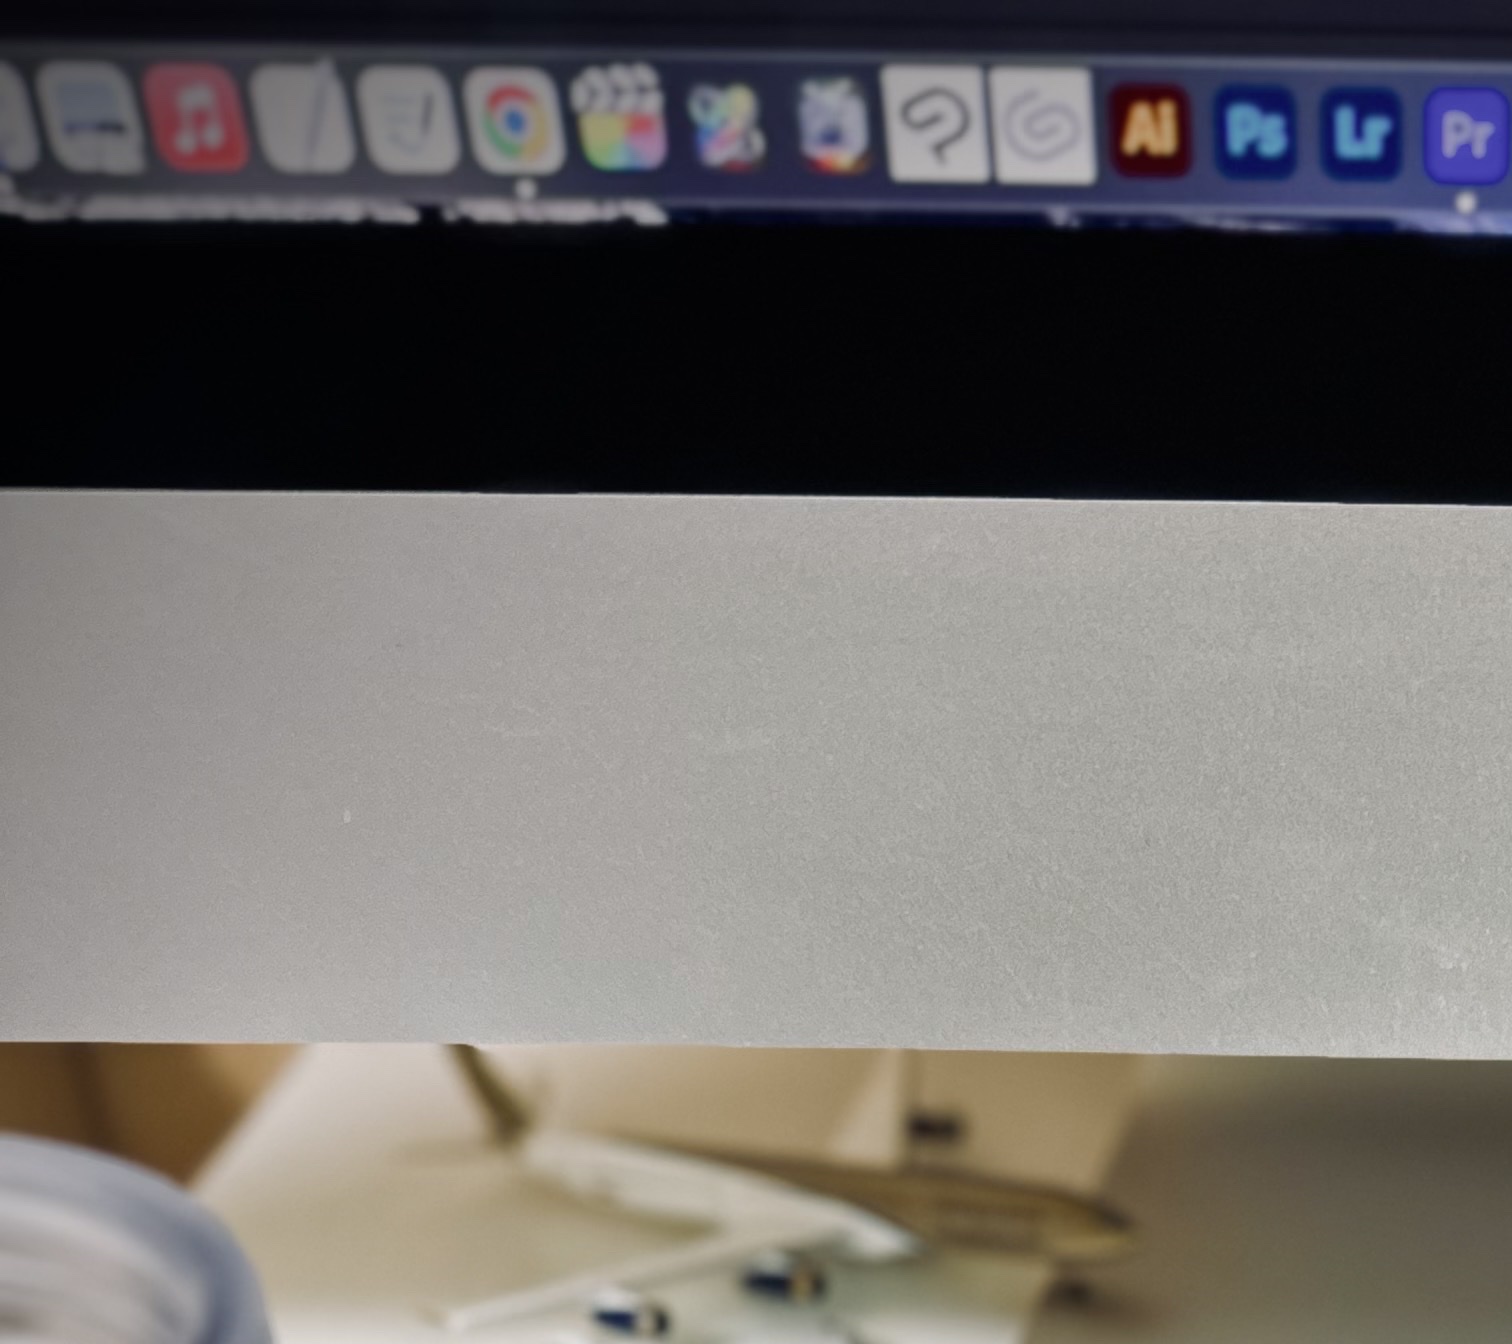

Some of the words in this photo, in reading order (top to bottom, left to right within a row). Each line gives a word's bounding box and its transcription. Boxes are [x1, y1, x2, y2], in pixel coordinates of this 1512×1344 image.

[1121, 98, 1178, 158] Ai
[1226, 102, 1288, 159] Ps
[1334, 105, 1394, 160] Lr
[1440, 109, 1497, 160] Pr
